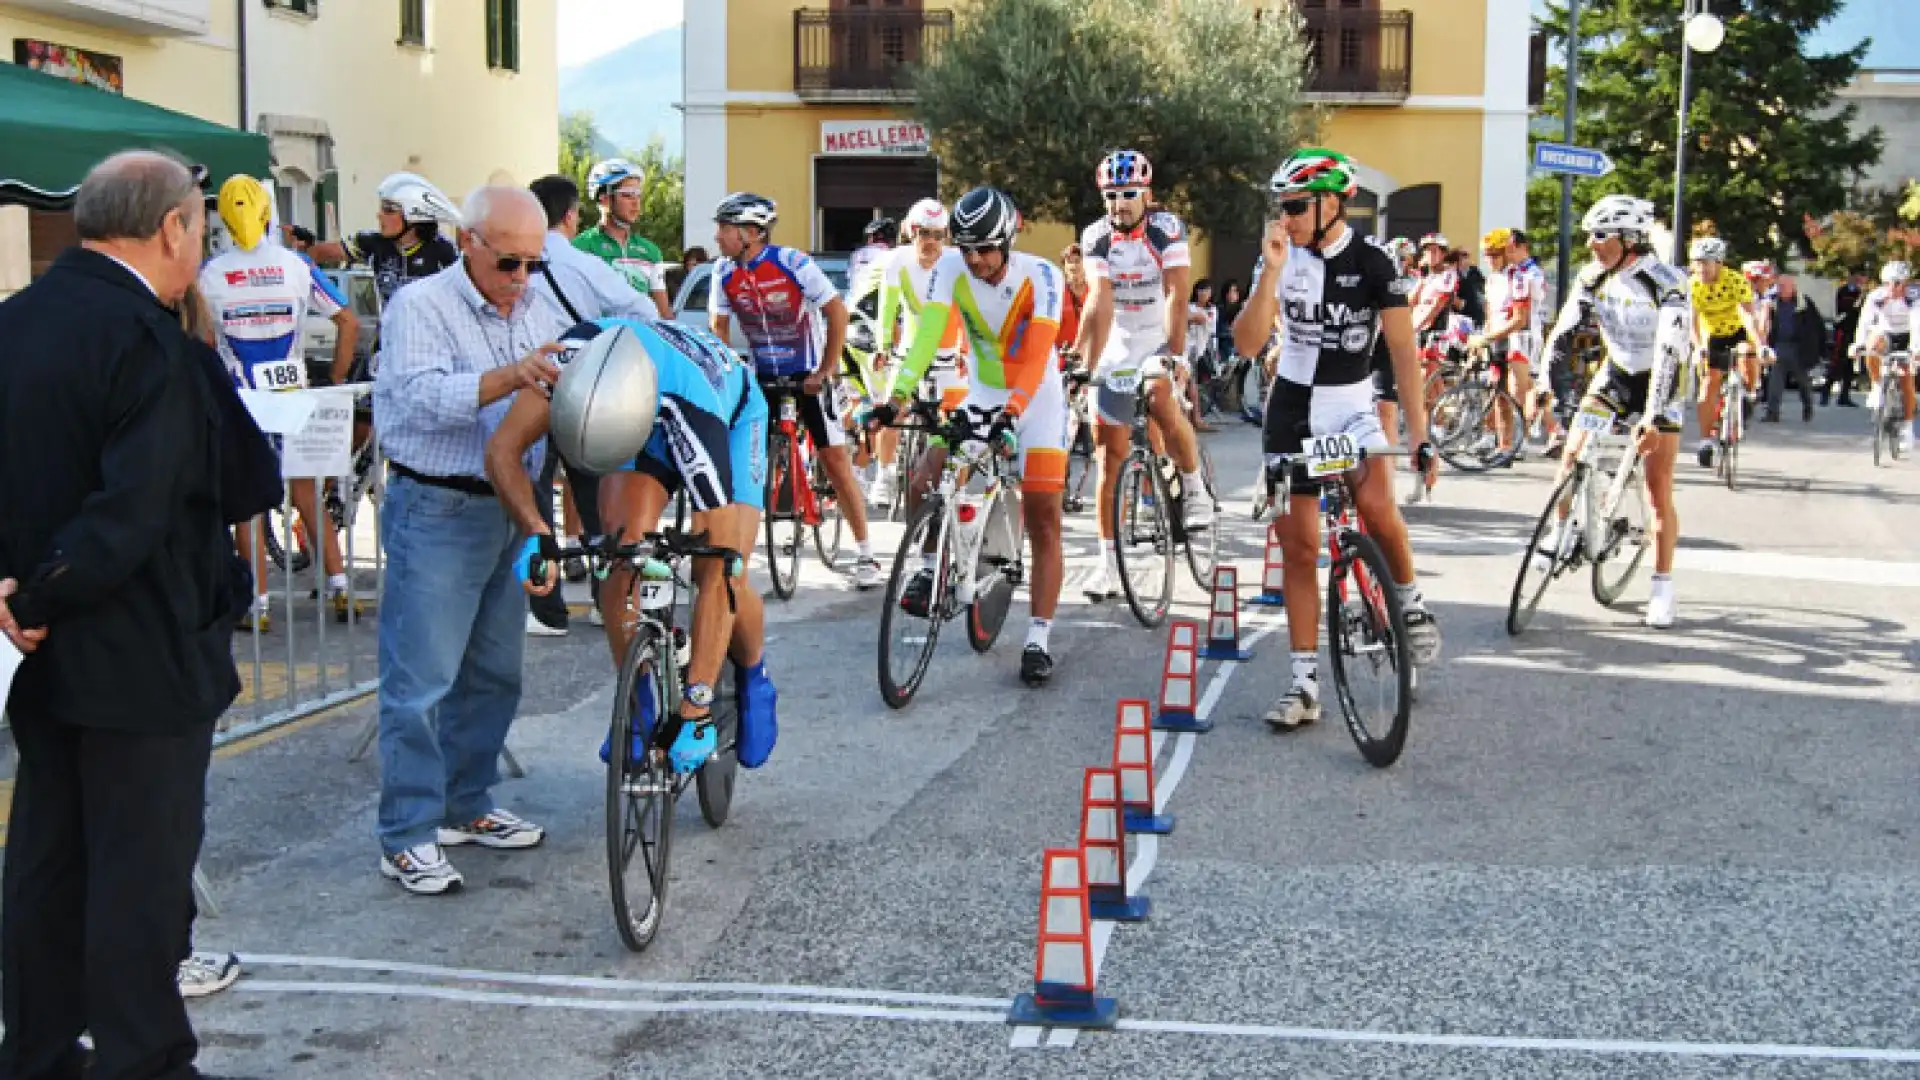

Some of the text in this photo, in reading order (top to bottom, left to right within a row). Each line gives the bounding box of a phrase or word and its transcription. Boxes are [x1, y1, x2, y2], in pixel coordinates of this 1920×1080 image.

[826, 125, 925, 152] MACELLERIA
[263, 364, 298, 386] 188
[1312, 434, 1353, 461] 400
